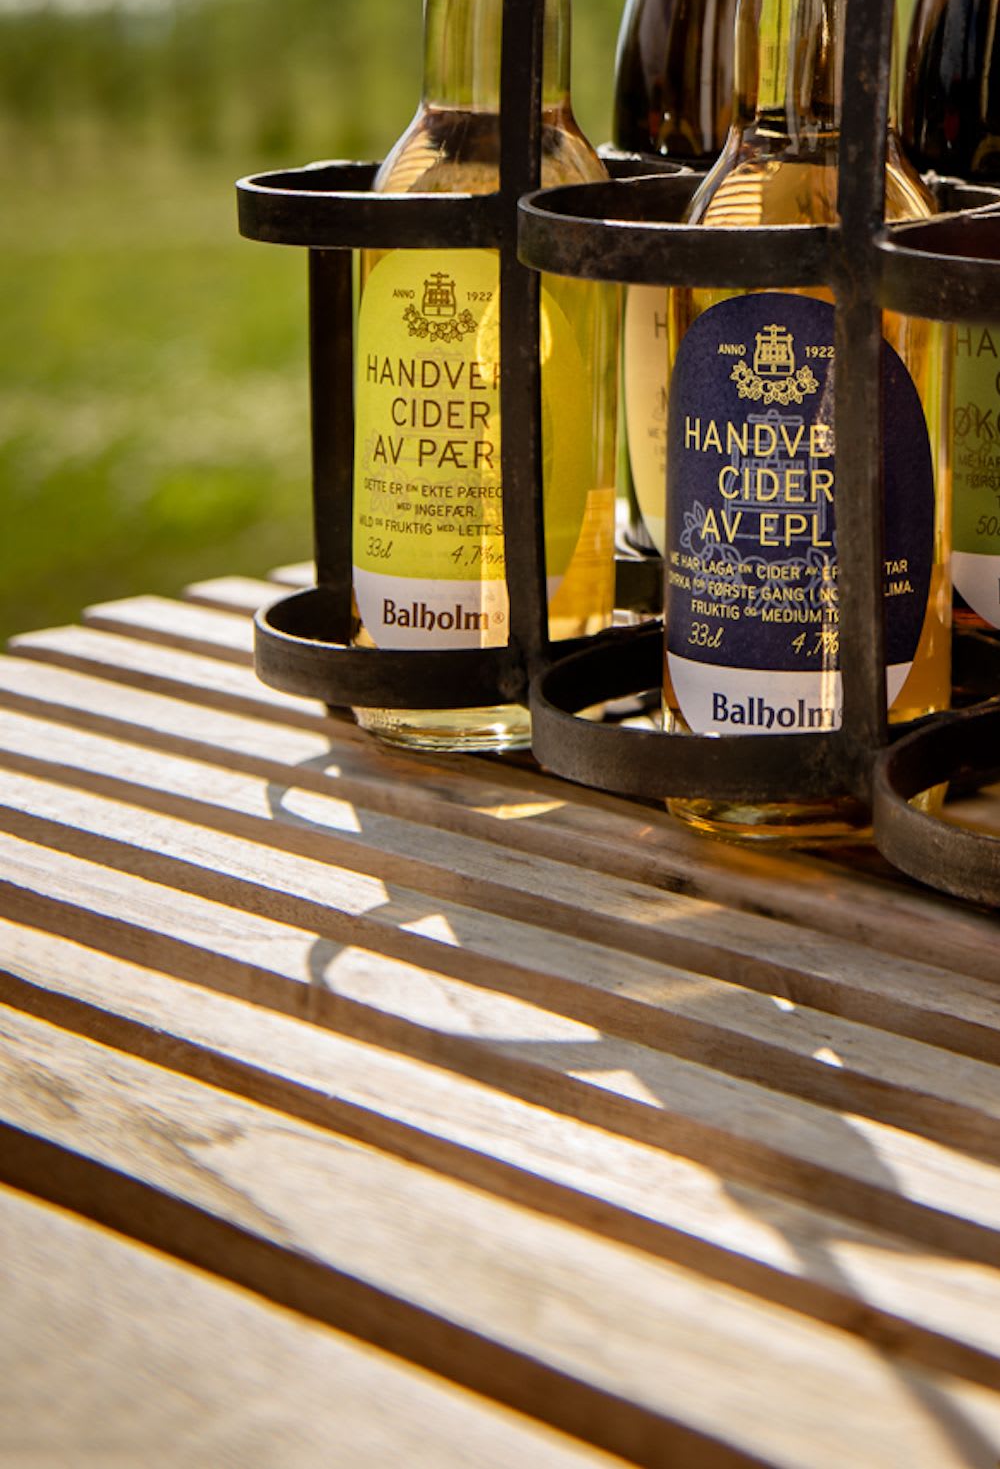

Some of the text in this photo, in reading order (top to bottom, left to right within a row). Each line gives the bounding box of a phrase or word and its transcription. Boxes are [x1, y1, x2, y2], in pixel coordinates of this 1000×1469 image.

[393, 290, 493, 301] ANNO 1922
[718, 343, 835, 358] ANNO 1922
[391, 398, 490, 430] CIDER
[685, 416, 835, 457] HANDVE
[373, 435, 495, 469] AV PÆR
[390, 482, 403, 494] ER
[421, 485, 453, 498] EKTE
[457, 486, 503, 498] PÆREC
[718, 466, 835, 502] CIDER
[415, 504, 478, 517] INGEFÆR.
[385, 519, 432, 535] FRUKTIG
[437, 525, 455, 533] MED
[458, 525, 492, 537] LETT
[700, 508, 833, 548] AV EPL
[366, 536, 393, 559] 33cl
[681, 555, 700, 571] HAR
[702, 560, 734, 576] LAGA
[756, 564, 800, 580] CIDER
[805, 566, 818, 575] AV
[885, 559, 908, 575] TAR
[707, 581, 756, 600] FØRSTE
[761, 587, 805, 602] GANG
[809, 588, 814, 601] I
[691, 599, 740, 620] FRUKTIG
[743, 607, 757, 617] OG
[762, 609, 822, 623] MEDIUM
[688, 621, 840, 657] 33cl 4,7%
[712, 692, 842, 729] Balholm
